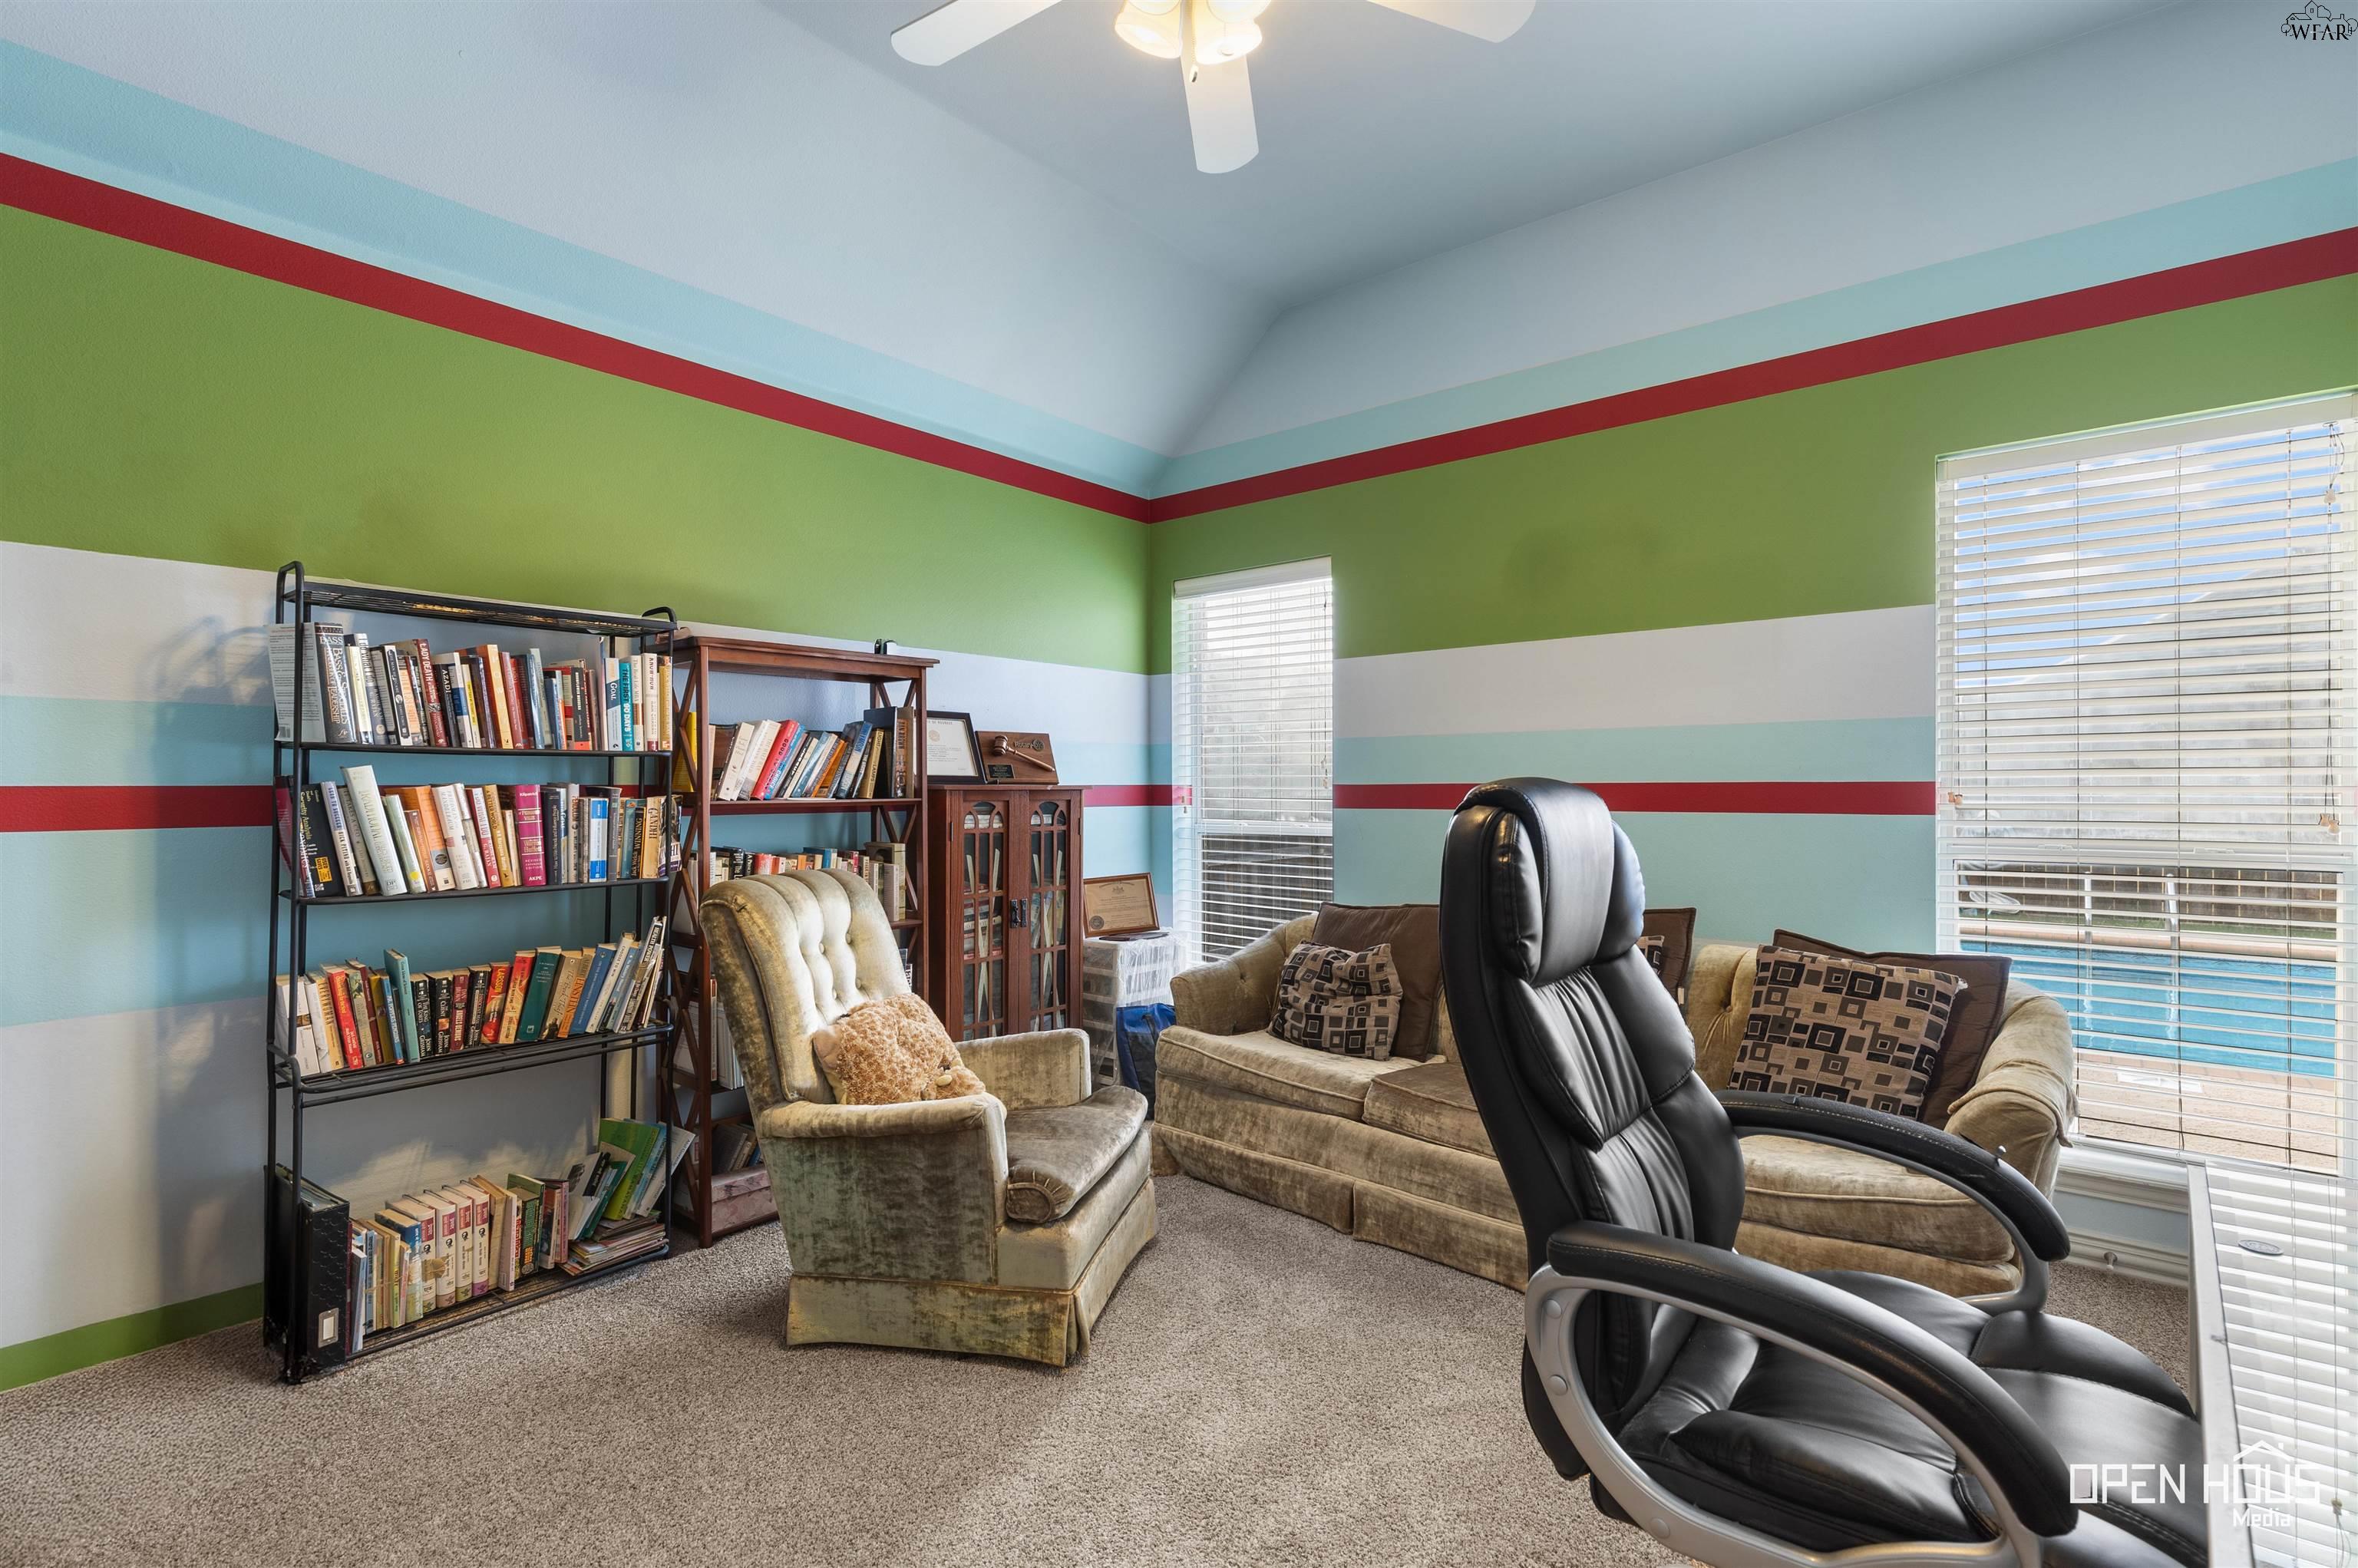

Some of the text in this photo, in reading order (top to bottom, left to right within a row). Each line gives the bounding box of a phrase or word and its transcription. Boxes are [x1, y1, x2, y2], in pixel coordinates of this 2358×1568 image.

[420, 643, 429, 659] LADY
[423, 660, 434, 682] DEATH
[442, 669, 451, 693] AZADI
[328, 685, 341, 724] LEADERSHIP
[623, 702, 630, 712] 90
[897, 721, 906, 749] DAN BROWN
[1014, 741, 1032, 749] Rotary
[779, 738, 789, 756] GOOD
[791, 748, 807, 776] LEGACY
[770, 770, 781, 789] CHOICE
[333, 807, 343, 828] SUCCEED
[346, 798, 355, 817] TAKES
[477, 806, 487, 823] WHAT
[304, 815, 312, 840] Analysis
[634, 817, 642, 850] WINNING
[648, 807, 659, 839] GANDHI
[484, 849, 493, 867] RAJAN
[494, 969, 507, 992] LARSSON
[318, 982, 334, 1025] EVERYWOMAN
[566, 978, 585, 1013] EINSTEIN
